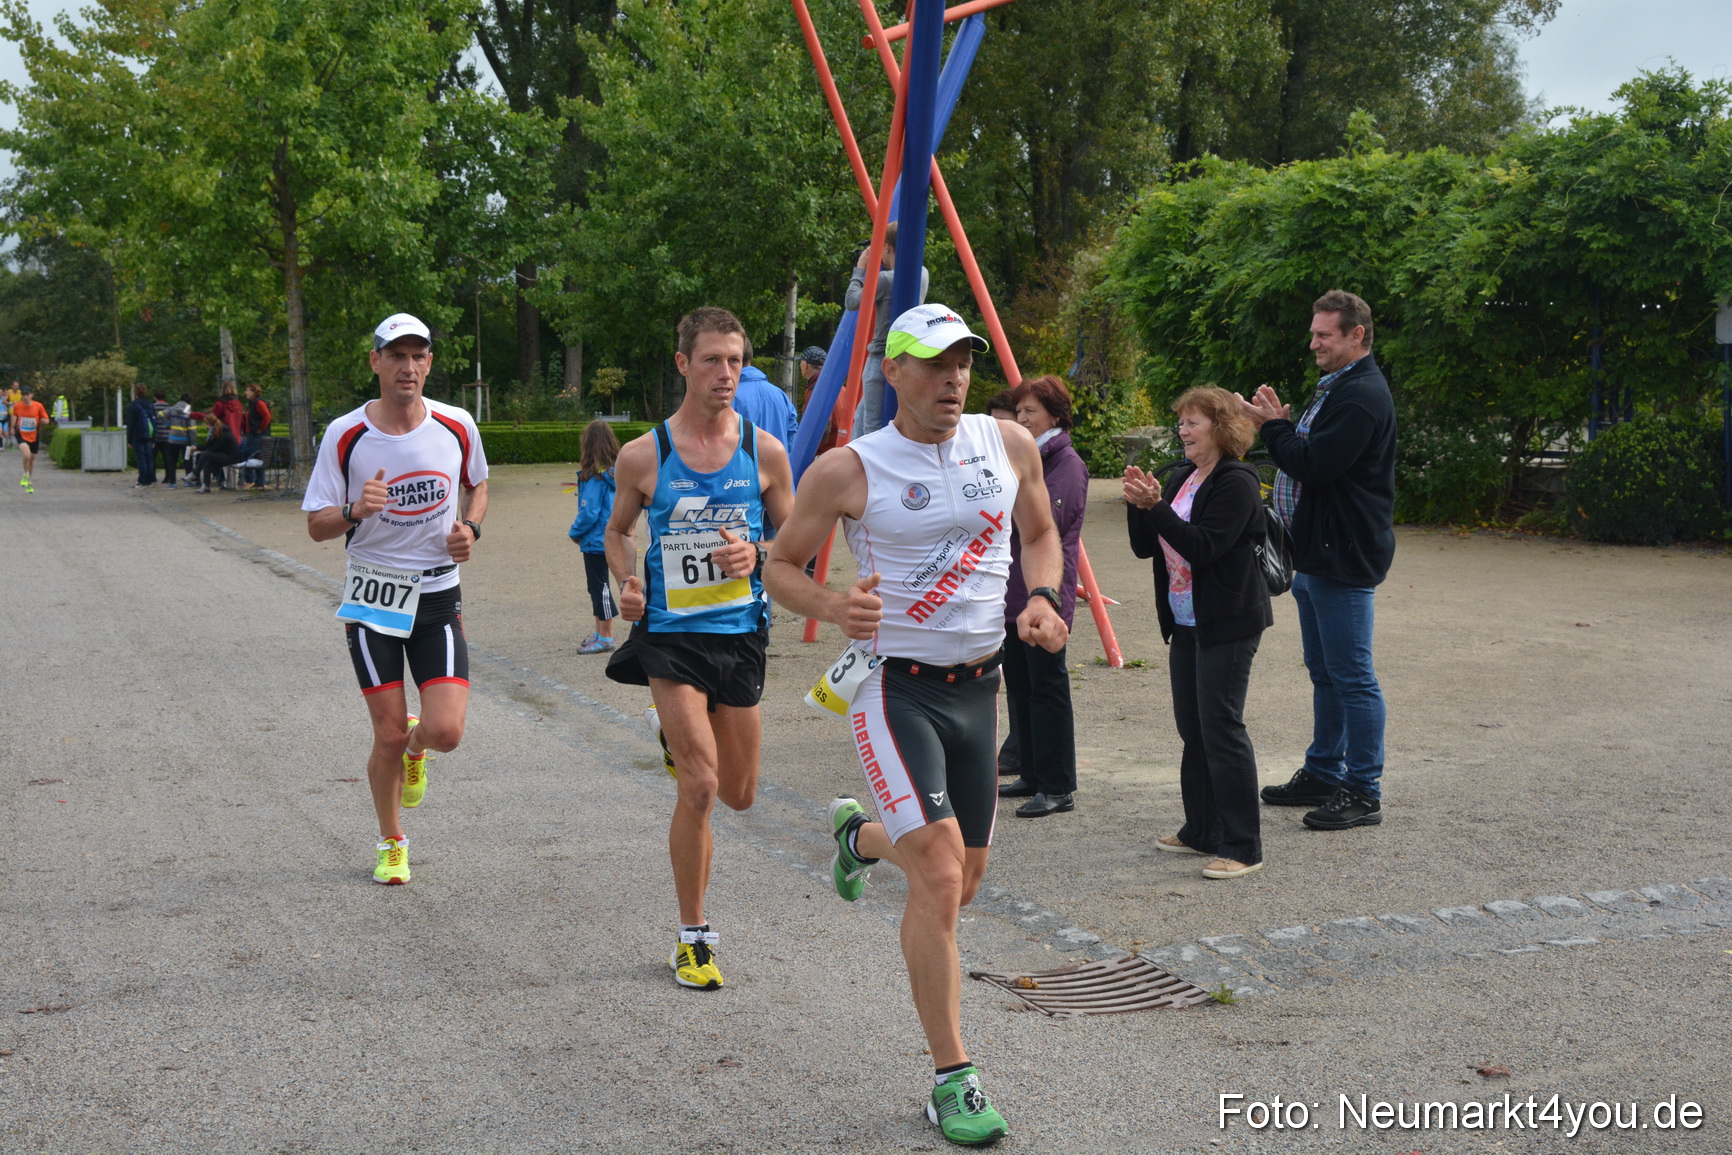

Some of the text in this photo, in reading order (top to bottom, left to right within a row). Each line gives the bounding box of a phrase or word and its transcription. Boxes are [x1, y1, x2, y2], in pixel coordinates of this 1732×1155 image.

[387, 479, 437, 497] RHART
[733, 479, 751, 488] asics
[397, 489, 445, 507] JÄNIG
[378, 513, 390, 523] Das
[390, 519, 424, 527] sportliche
[663, 539, 730, 551] PARTL Neumar
[349, 563, 408, 581] PARTL Neumarkt
[681, 552, 729, 584] 61
[905, 509, 1005, 624] memmert
[911, 538, 954, 588] infinity-sport
[351, 575, 414, 609] 2007
[831, 652, 856, 684] 3
[852, 711, 912, 814] memmert
